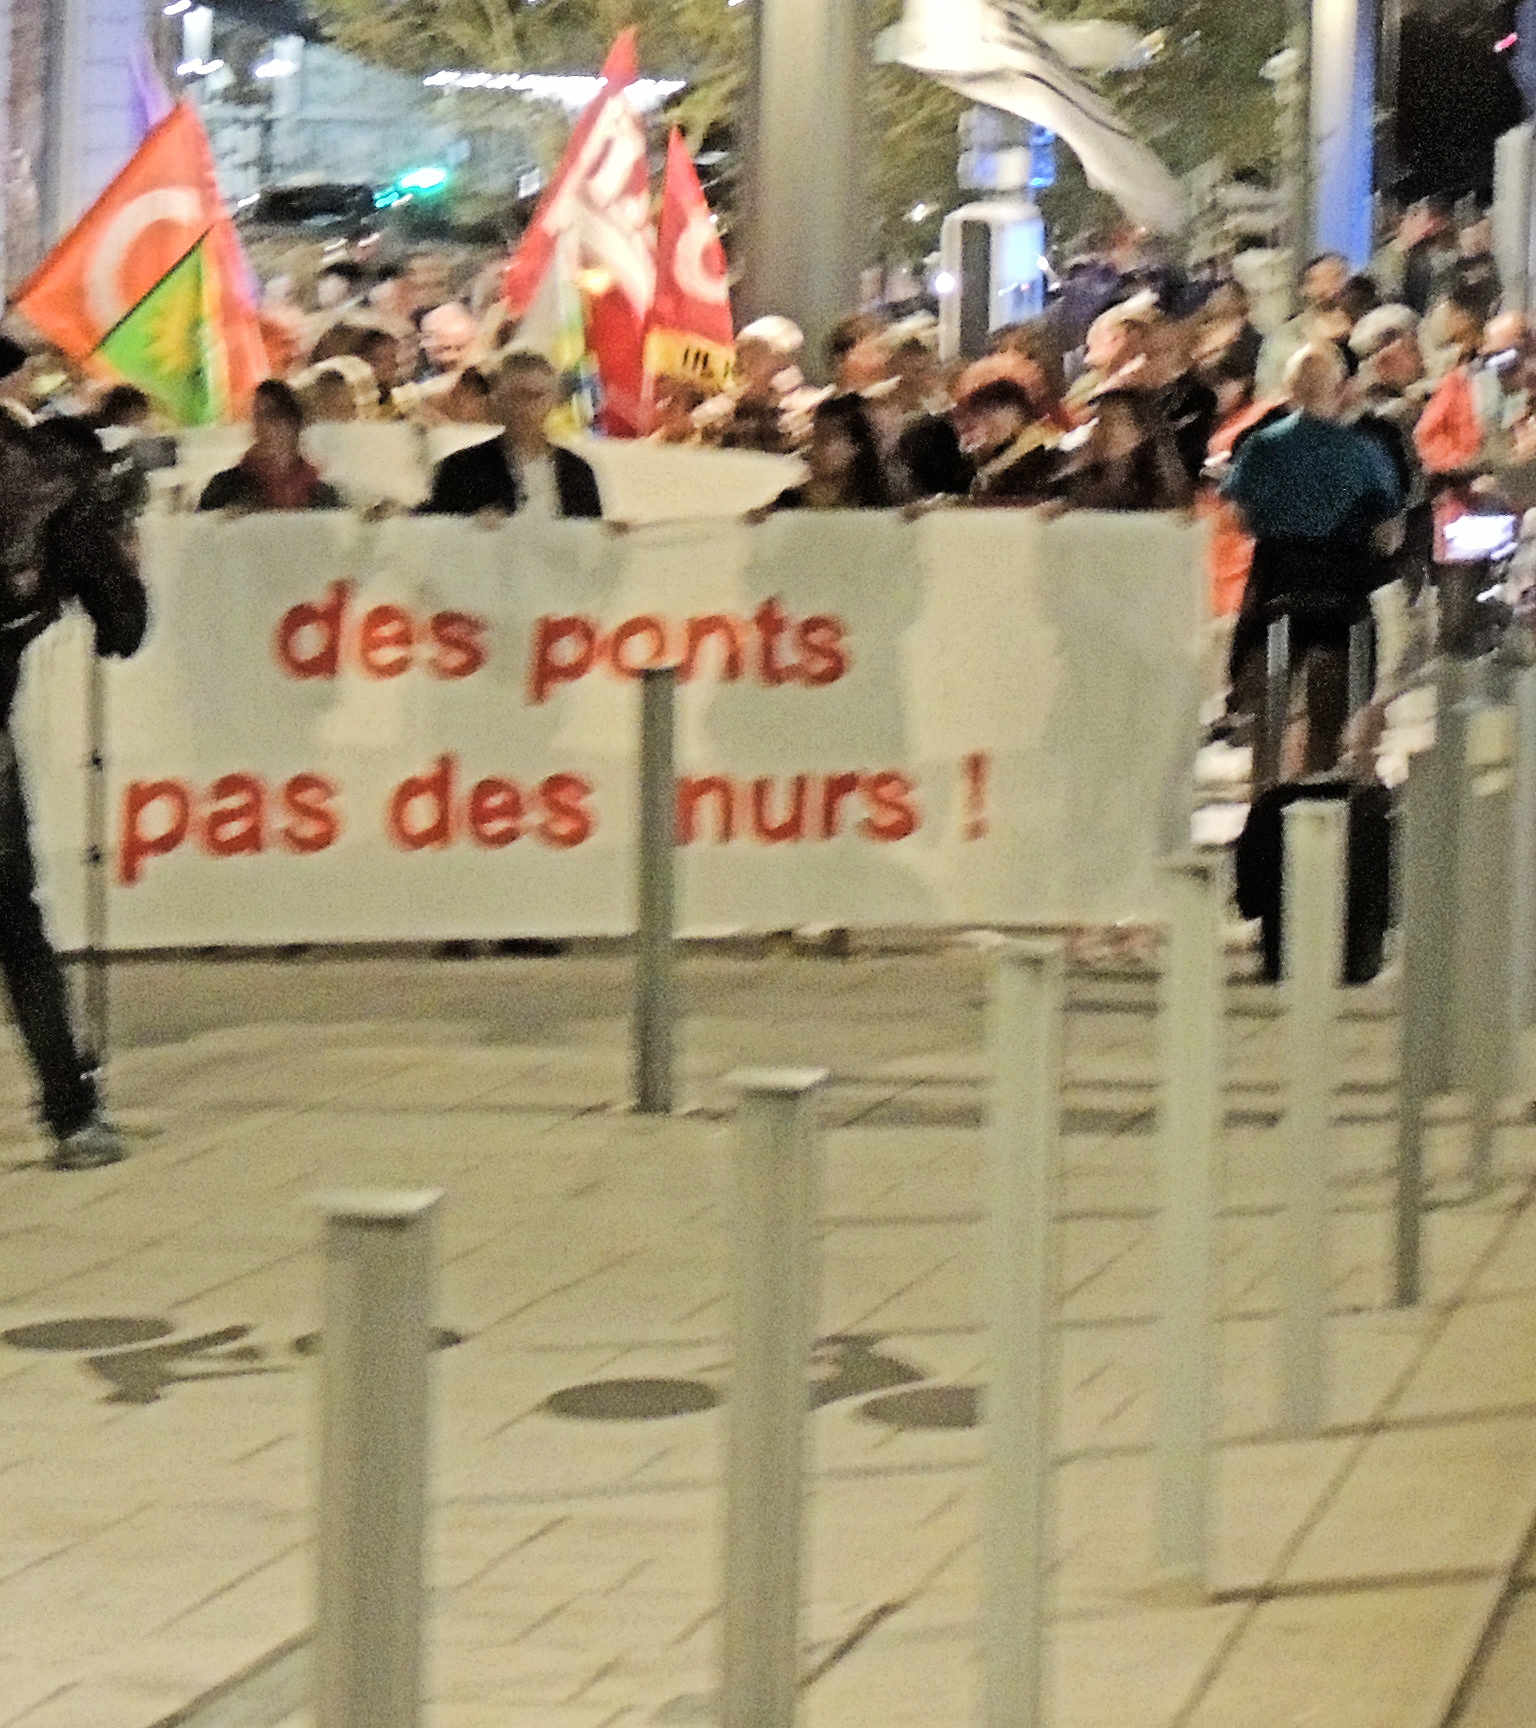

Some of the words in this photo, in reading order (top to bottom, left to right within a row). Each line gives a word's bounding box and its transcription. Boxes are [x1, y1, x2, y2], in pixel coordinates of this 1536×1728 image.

[277, 579, 487, 678] des
[526, 592, 849, 705] ponts
[119, 772, 339, 885] pas
[386, 752, 595, 852] des
[963, 749, 989, 841] !
